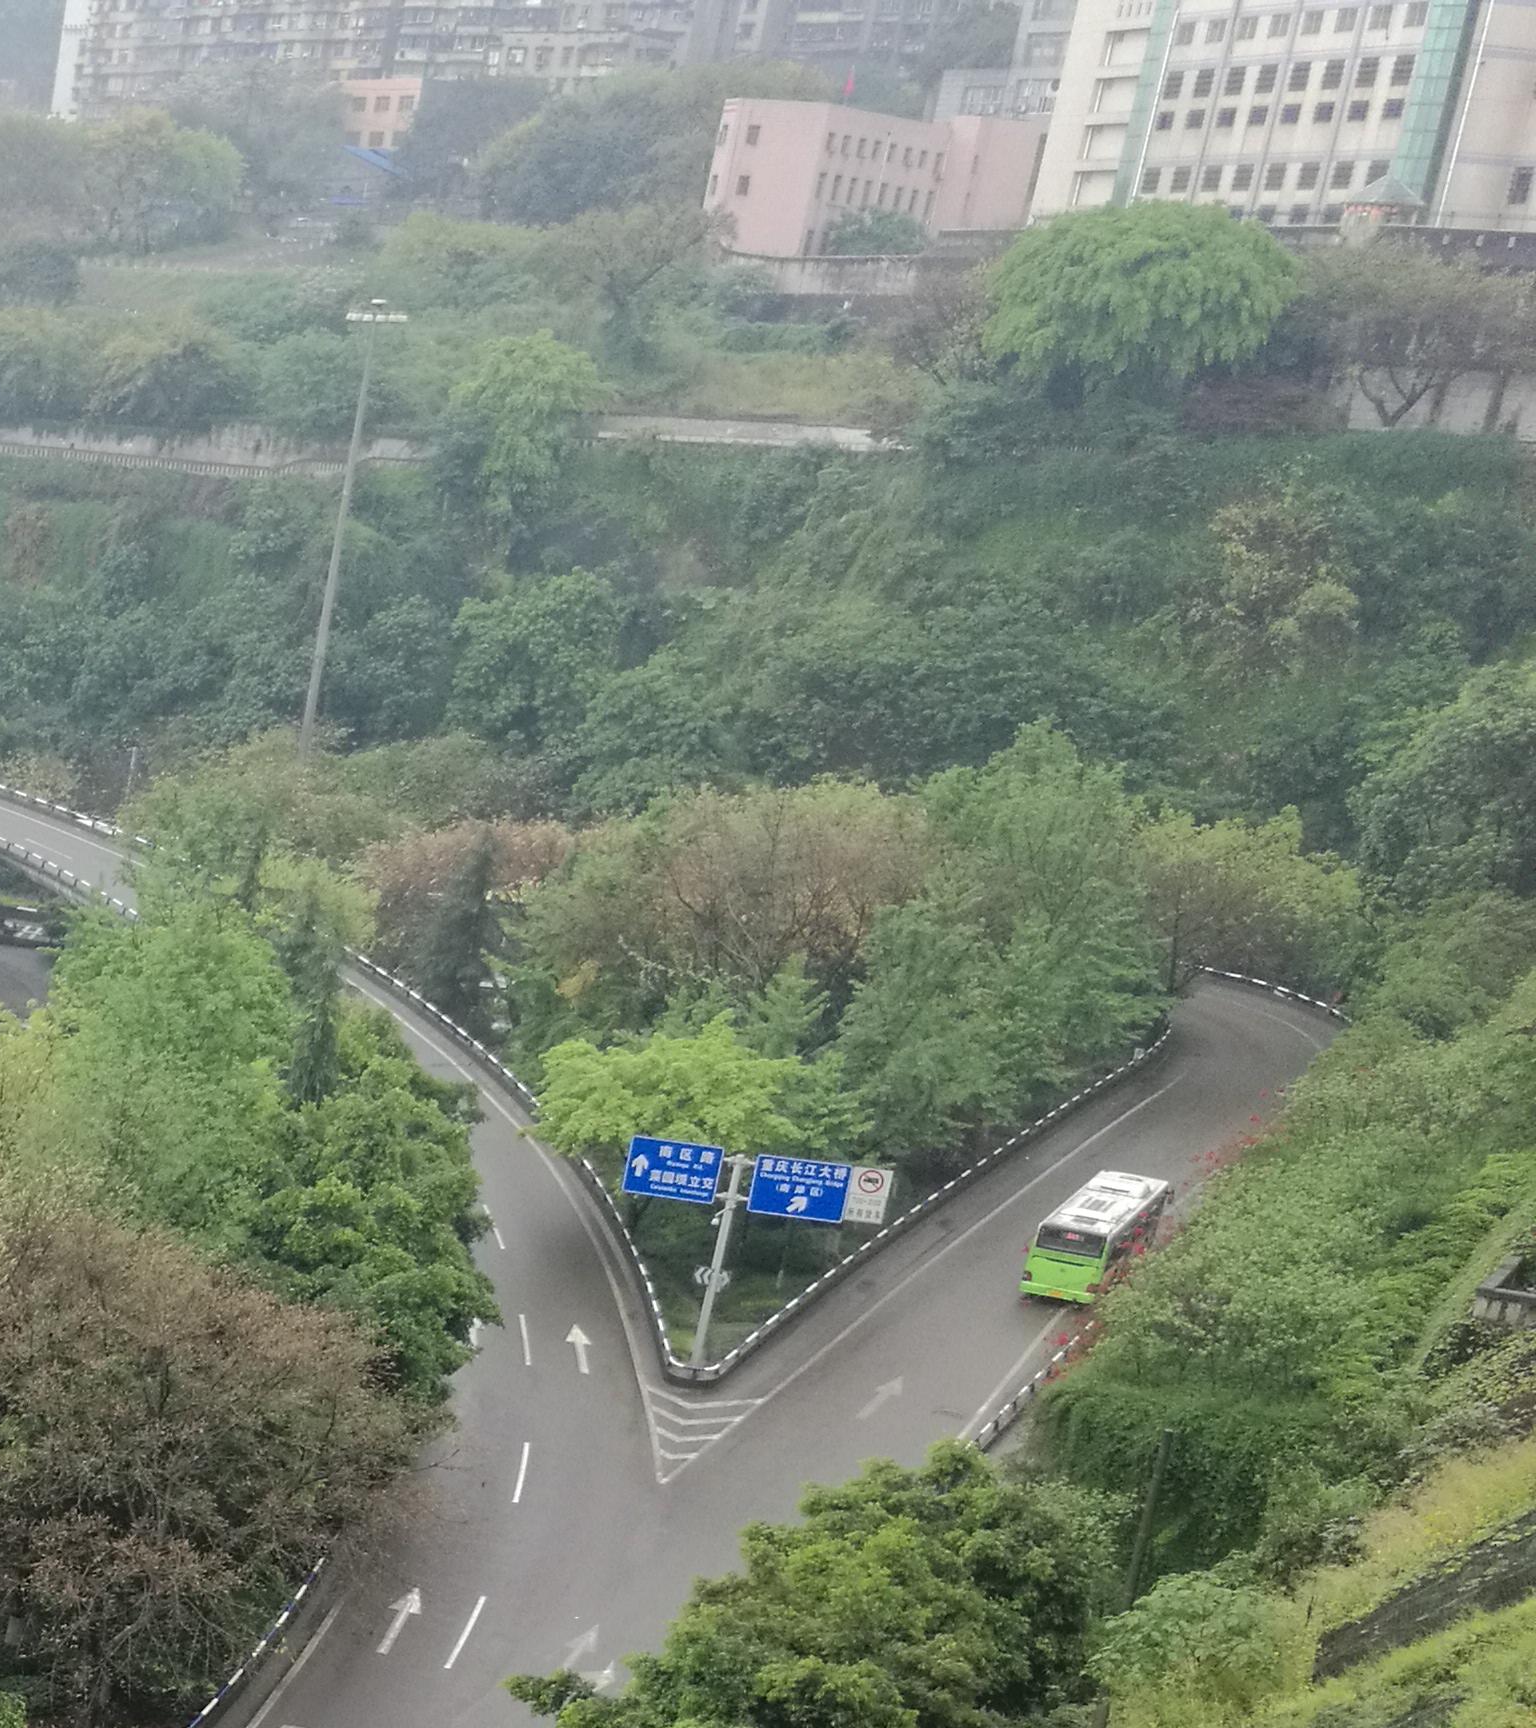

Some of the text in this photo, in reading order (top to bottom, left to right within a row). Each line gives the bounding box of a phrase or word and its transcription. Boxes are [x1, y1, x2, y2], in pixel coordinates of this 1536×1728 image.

[760, 1158, 848, 1181] 重庆长江大桥
